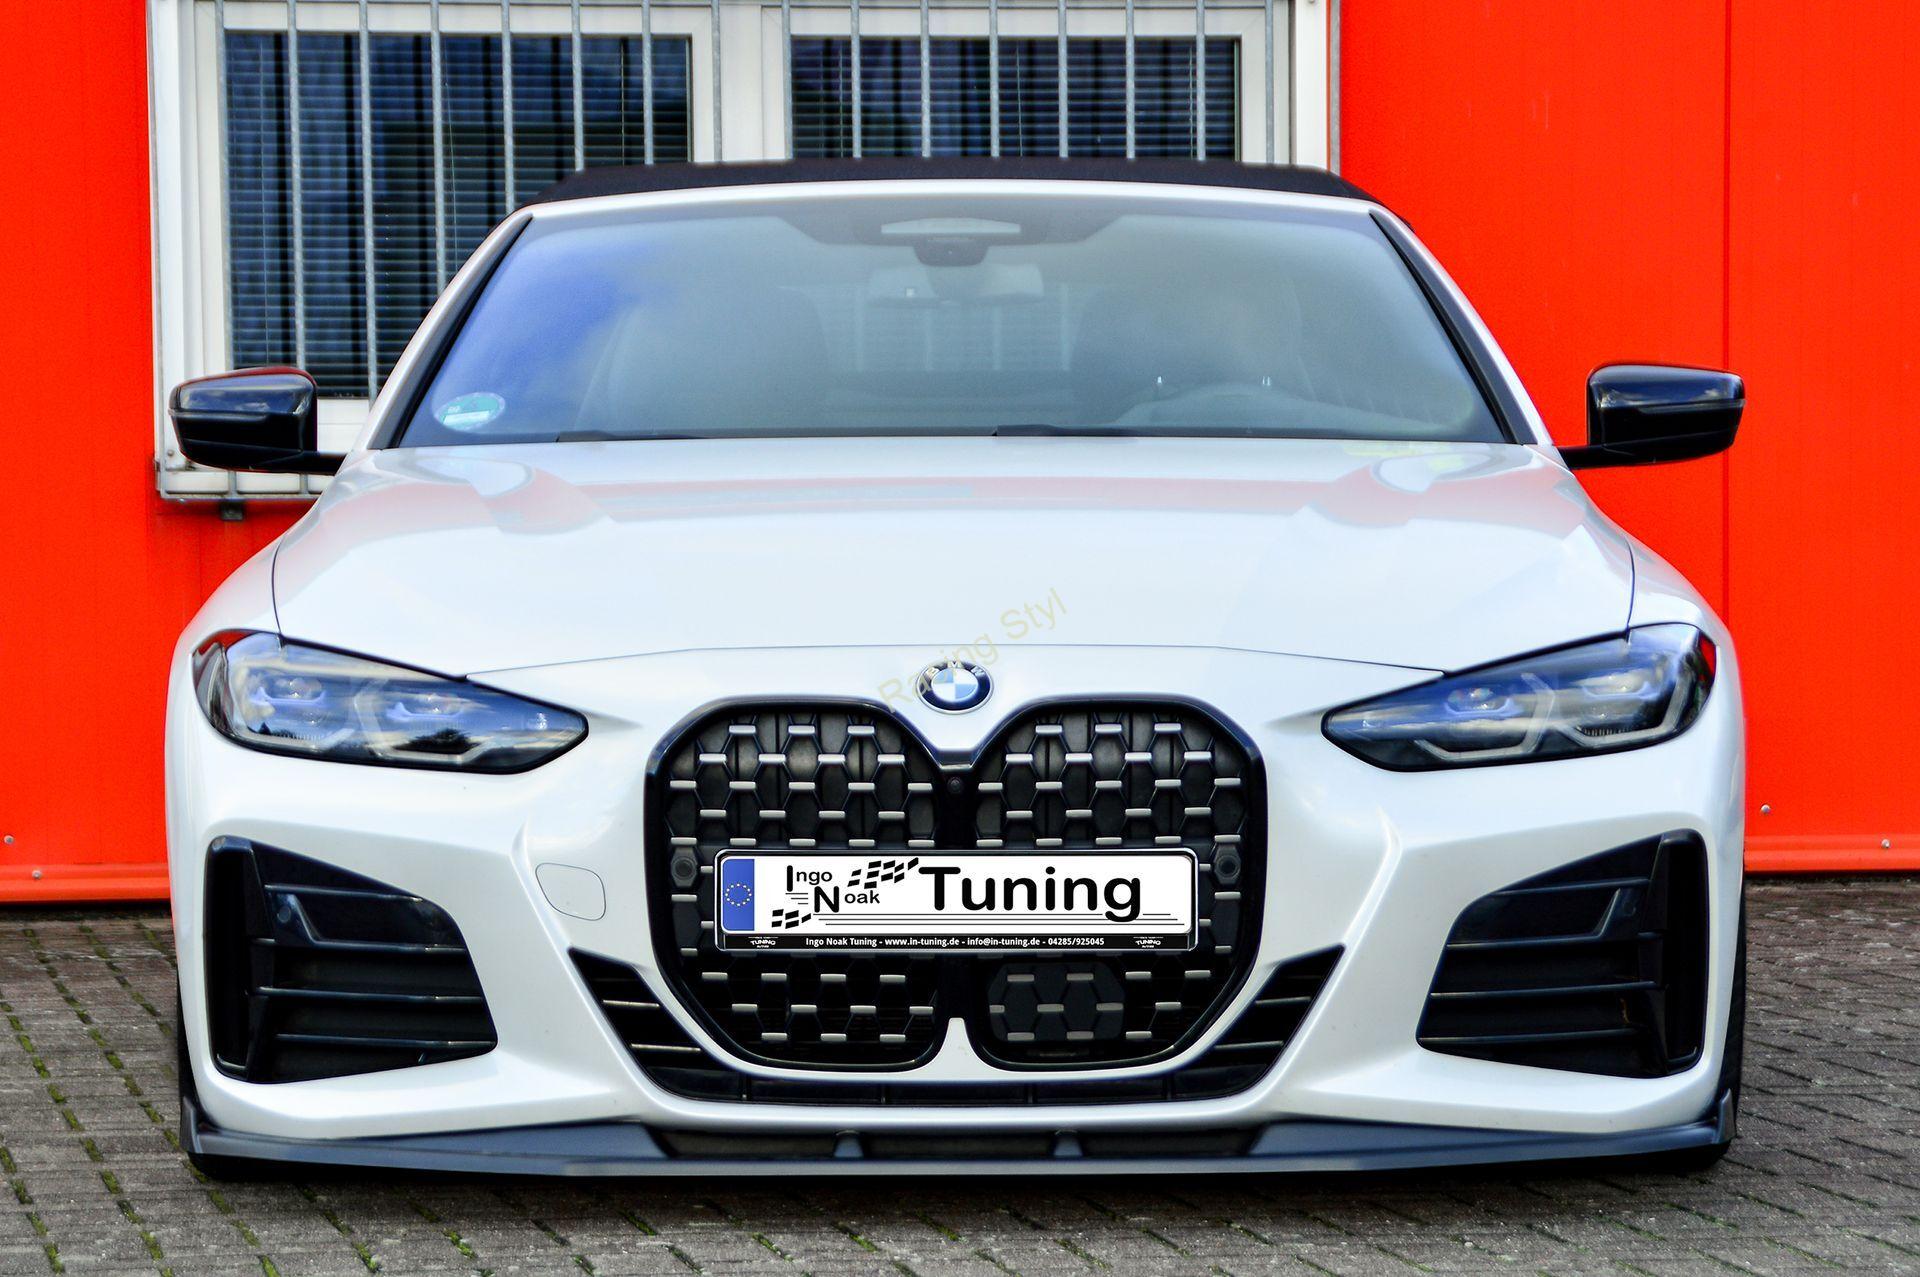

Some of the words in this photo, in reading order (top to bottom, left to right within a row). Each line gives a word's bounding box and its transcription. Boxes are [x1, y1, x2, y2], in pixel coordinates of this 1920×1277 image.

[925, 660, 986, 678] BMW
[786, 865, 833, 892] Ingo
[814, 885, 881, 913] Noak
[918, 866, 1141, 923] Tuning
[805, 937, 824, 948] Ingo
[826, 937, 848, 946] Noak
[850, 937, 877, 948] Tuning
[884, 937, 960, 948] www.in-tuning.de
[967, 937, 1040, 948] info@in-tuning.de
[1047, 937, 1105, 947] 04285/925045
